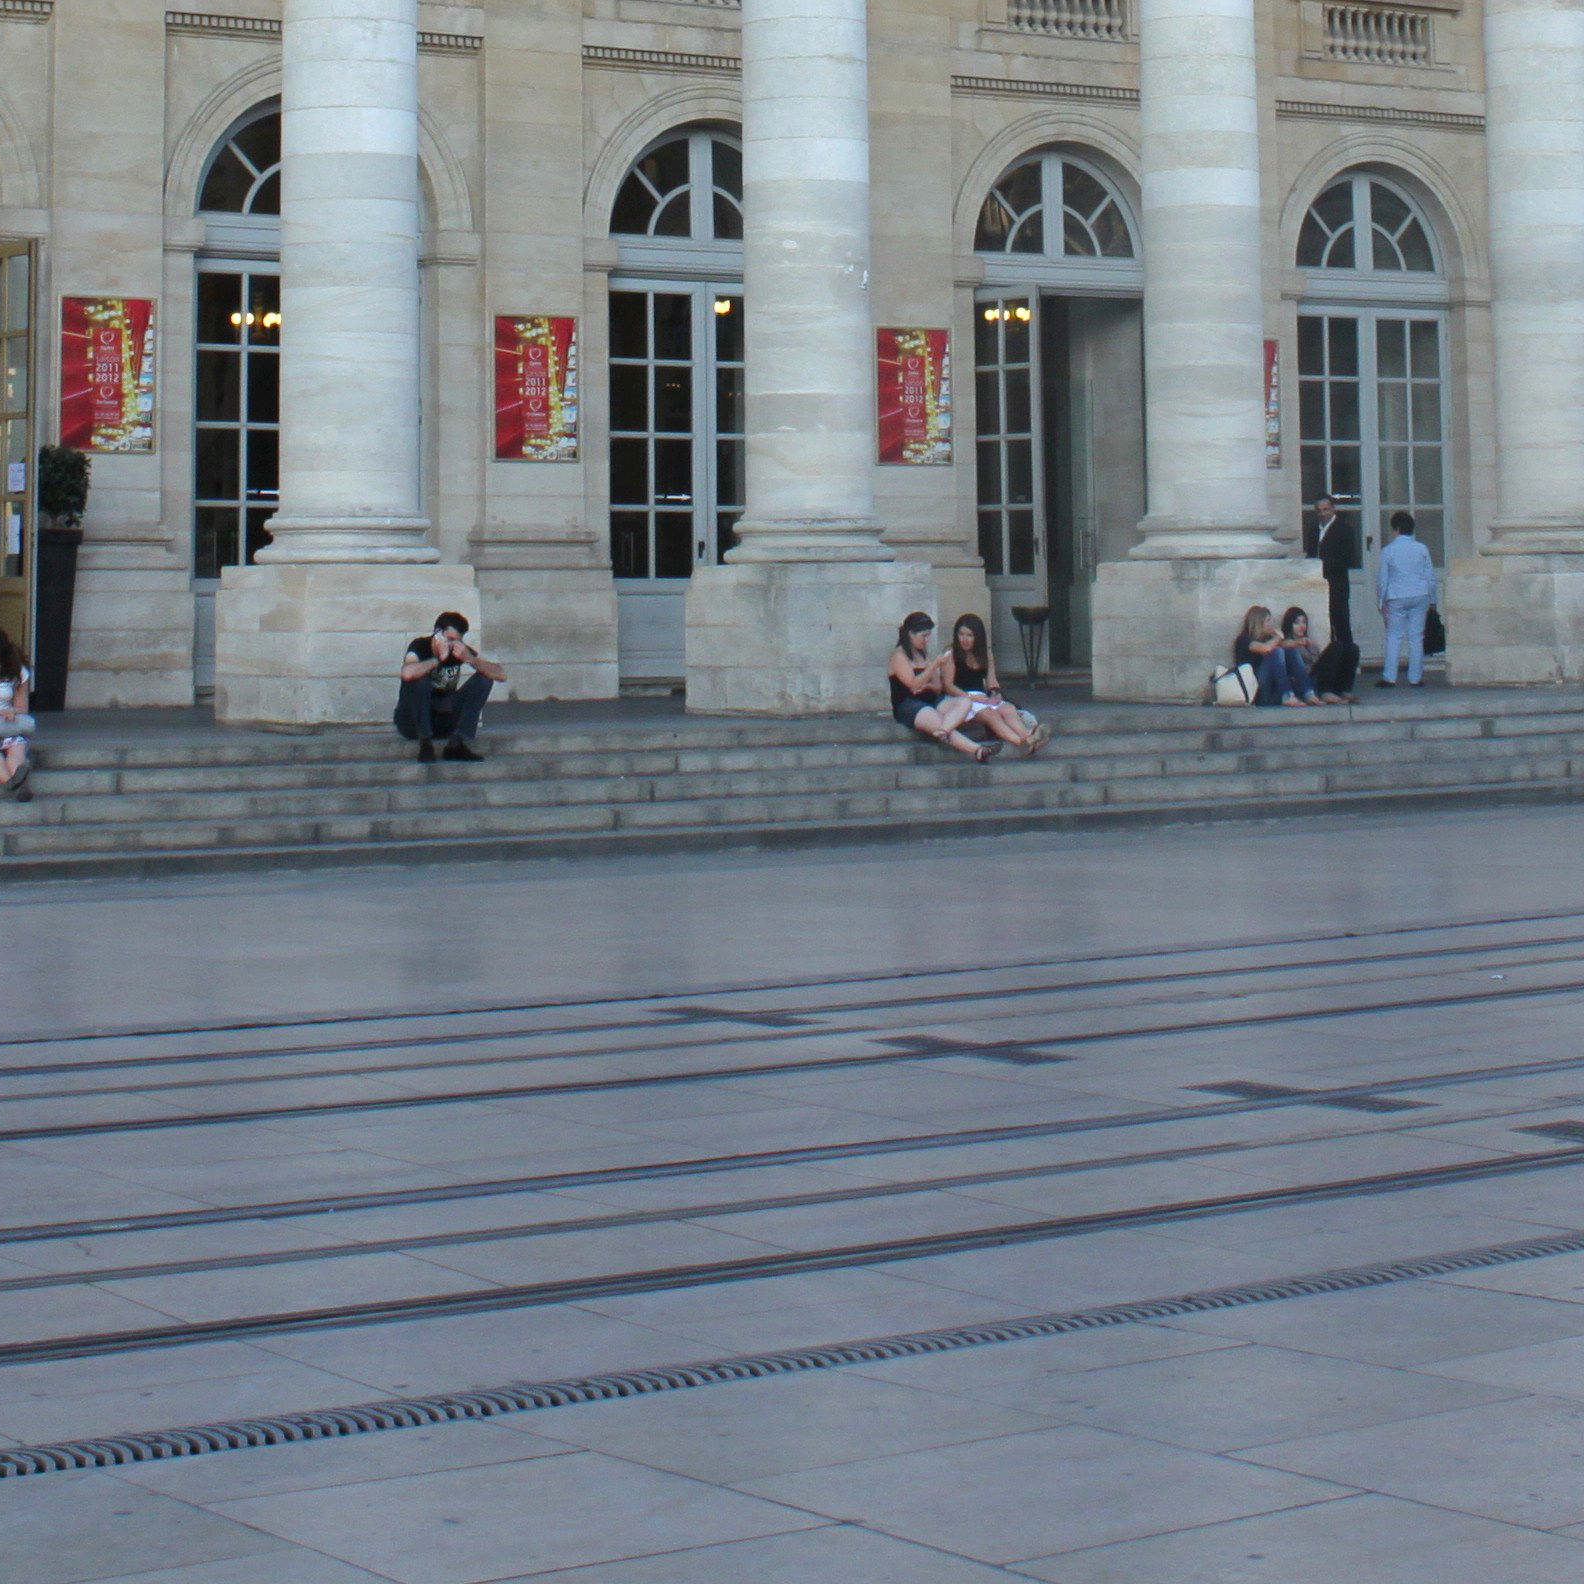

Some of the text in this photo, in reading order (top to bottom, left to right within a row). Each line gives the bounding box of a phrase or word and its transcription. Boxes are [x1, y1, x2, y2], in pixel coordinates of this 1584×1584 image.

[95, 362, 119, 372] 2011
[95, 372, 119, 383] 2012
[525, 377, 546, 386] 2011
[525, 386, 547, 396] 2012
[904, 386, 923, 394] 2011
[904, 395, 924, 404] 2012
